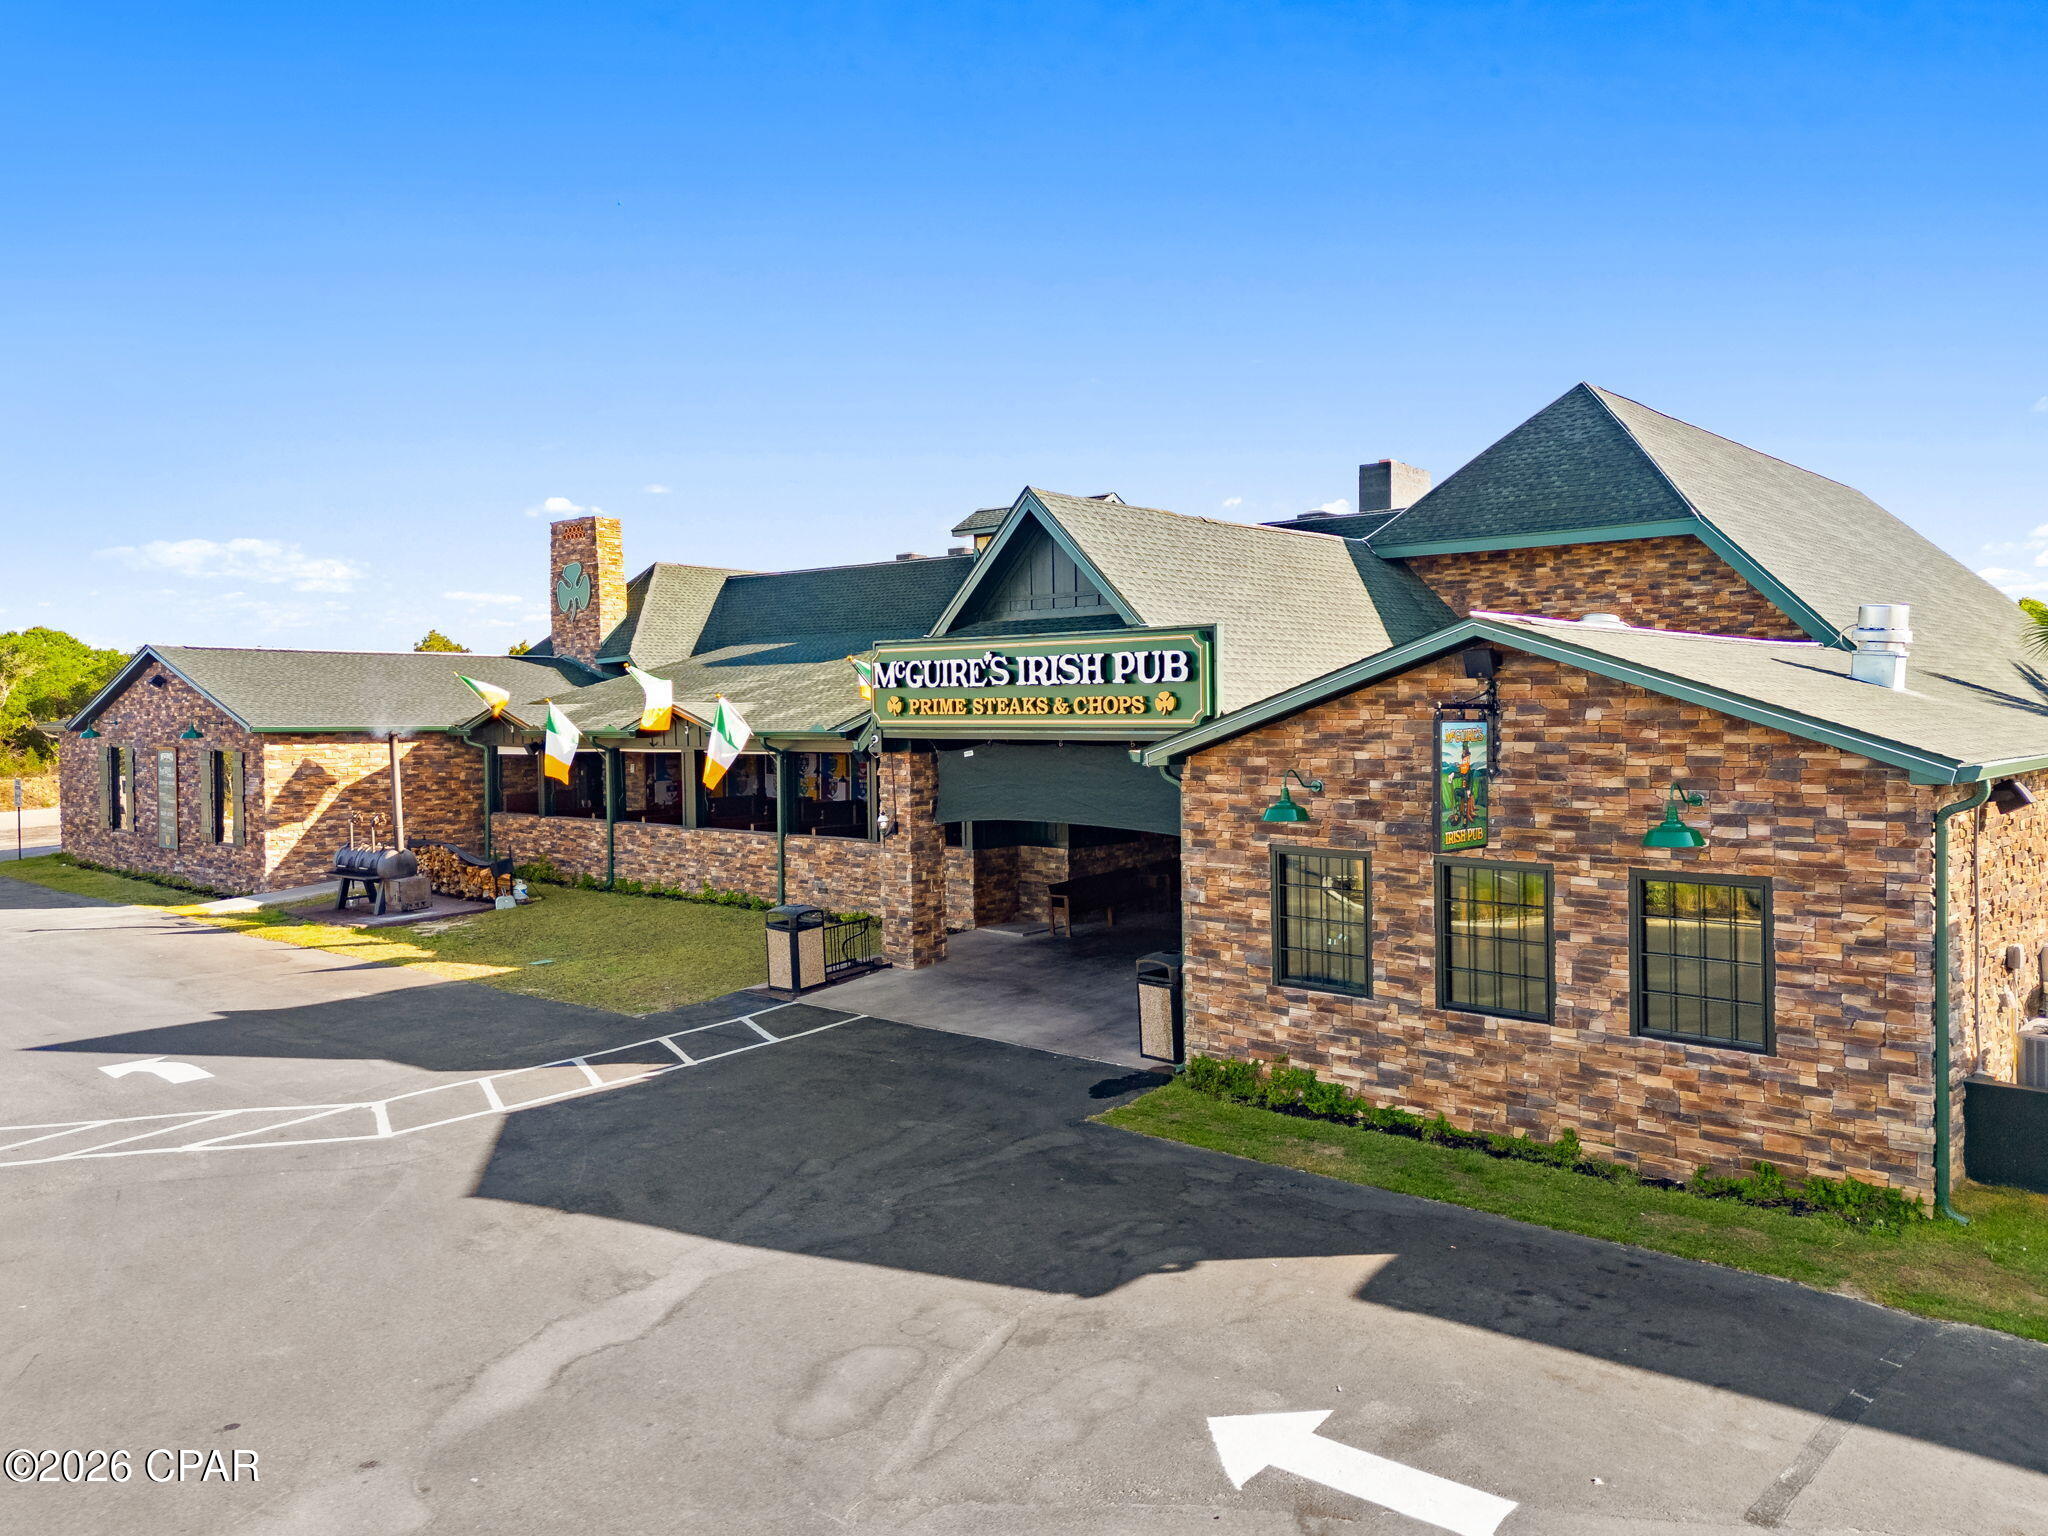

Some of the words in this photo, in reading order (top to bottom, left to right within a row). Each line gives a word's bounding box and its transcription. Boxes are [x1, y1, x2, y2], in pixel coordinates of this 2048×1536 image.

[1015, 653, 1105, 687] IRISH
[1112, 650, 1189, 685] PUB
[908, 698, 968, 716] PRIME
[972, 697, 1050, 716] STEAKS
[1053, 696, 1069, 715] &
[1073, 695, 1146, 715] CHOPS
[1445, 829, 1466, 845] IRISH
[1467, 827, 1484, 842] PUB
